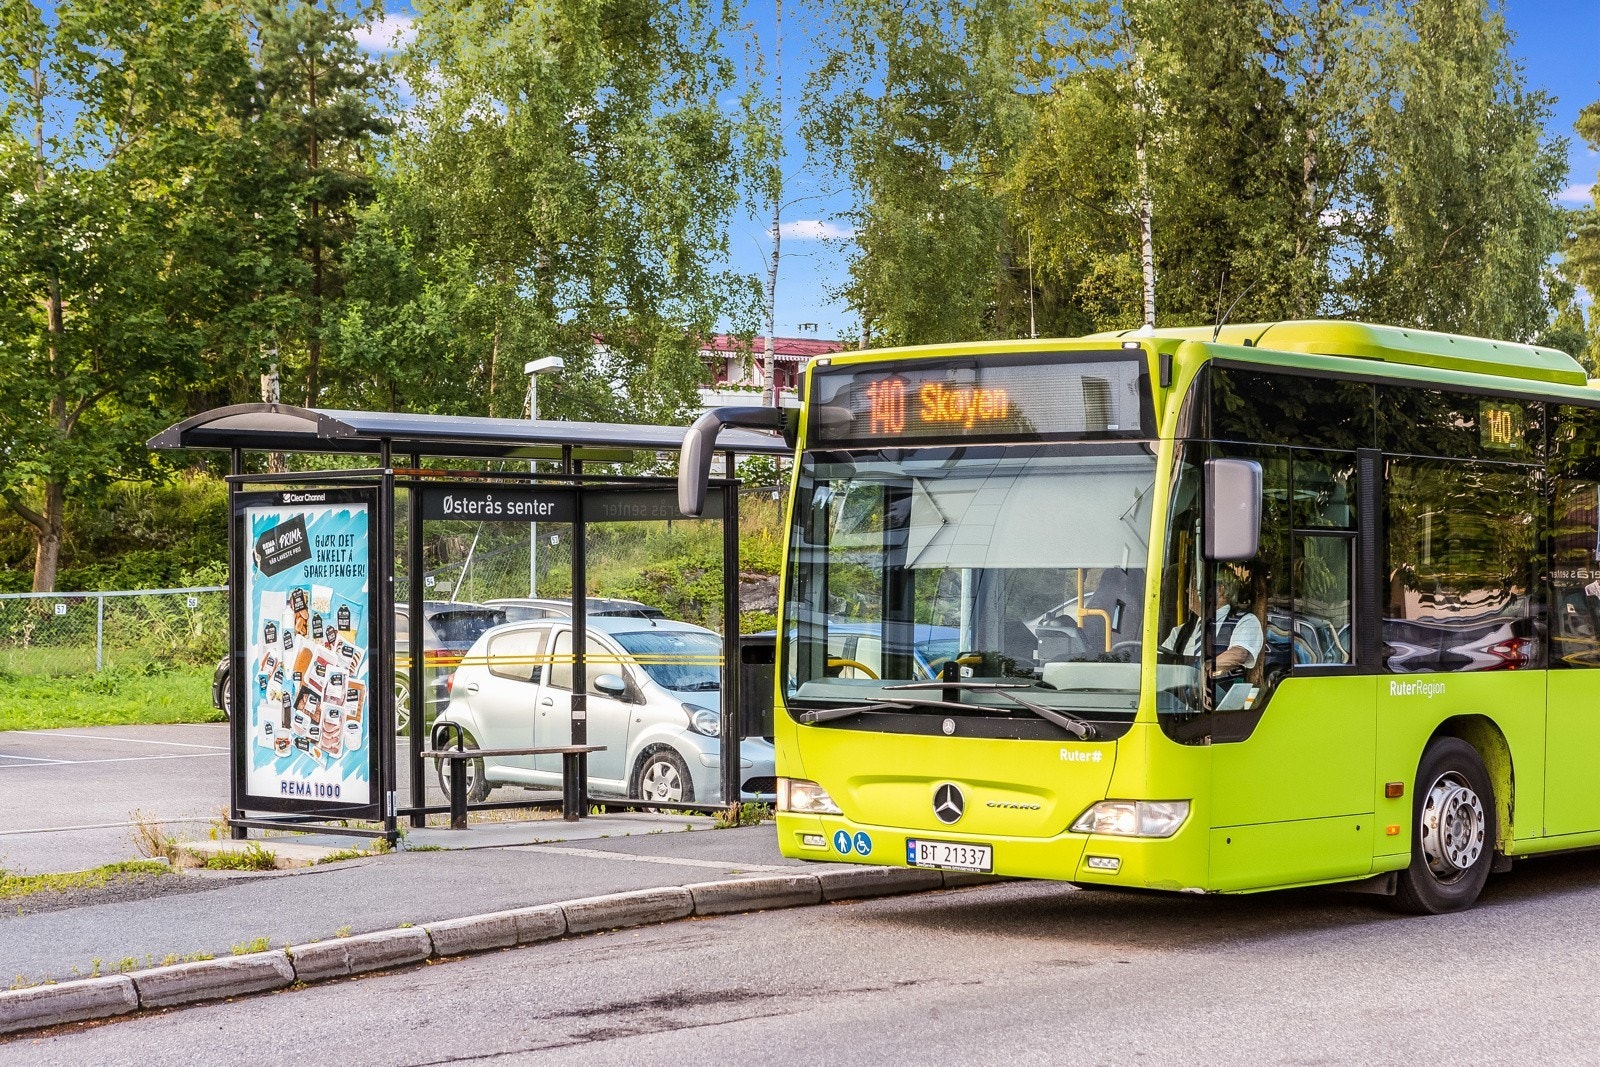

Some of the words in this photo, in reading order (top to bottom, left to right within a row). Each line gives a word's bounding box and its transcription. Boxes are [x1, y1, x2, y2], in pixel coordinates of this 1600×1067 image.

[867, 381, 904, 433] 140
[1488, 409, 1511, 443] 140
[291, 494, 304, 502] Clear
[304, 493, 325, 502] Channel
[443, 495, 502, 514] Østerås
[507, 499, 554, 515] senter
[279, 528, 302, 548] PRIMA
[315, 534, 336, 548] GJØR
[338, 534, 354, 547] DET
[317, 549, 346, 562] ENKELT
[348, 549, 353, 562] Å
[304, 564, 327, 578] SPARE
[329, 564, 365, 578] PENGER!
[56, 605, 64, 613] 57
[1390, 679, 1445, 698] RuterRegion
[281, 781, 311, 796] REMA
[315, 784, 340, 798] 1000
[986, 801, 1041, 810] CITARO
[921, 844, 937, 861] BT
[944, 846, 985, 866] 21337
